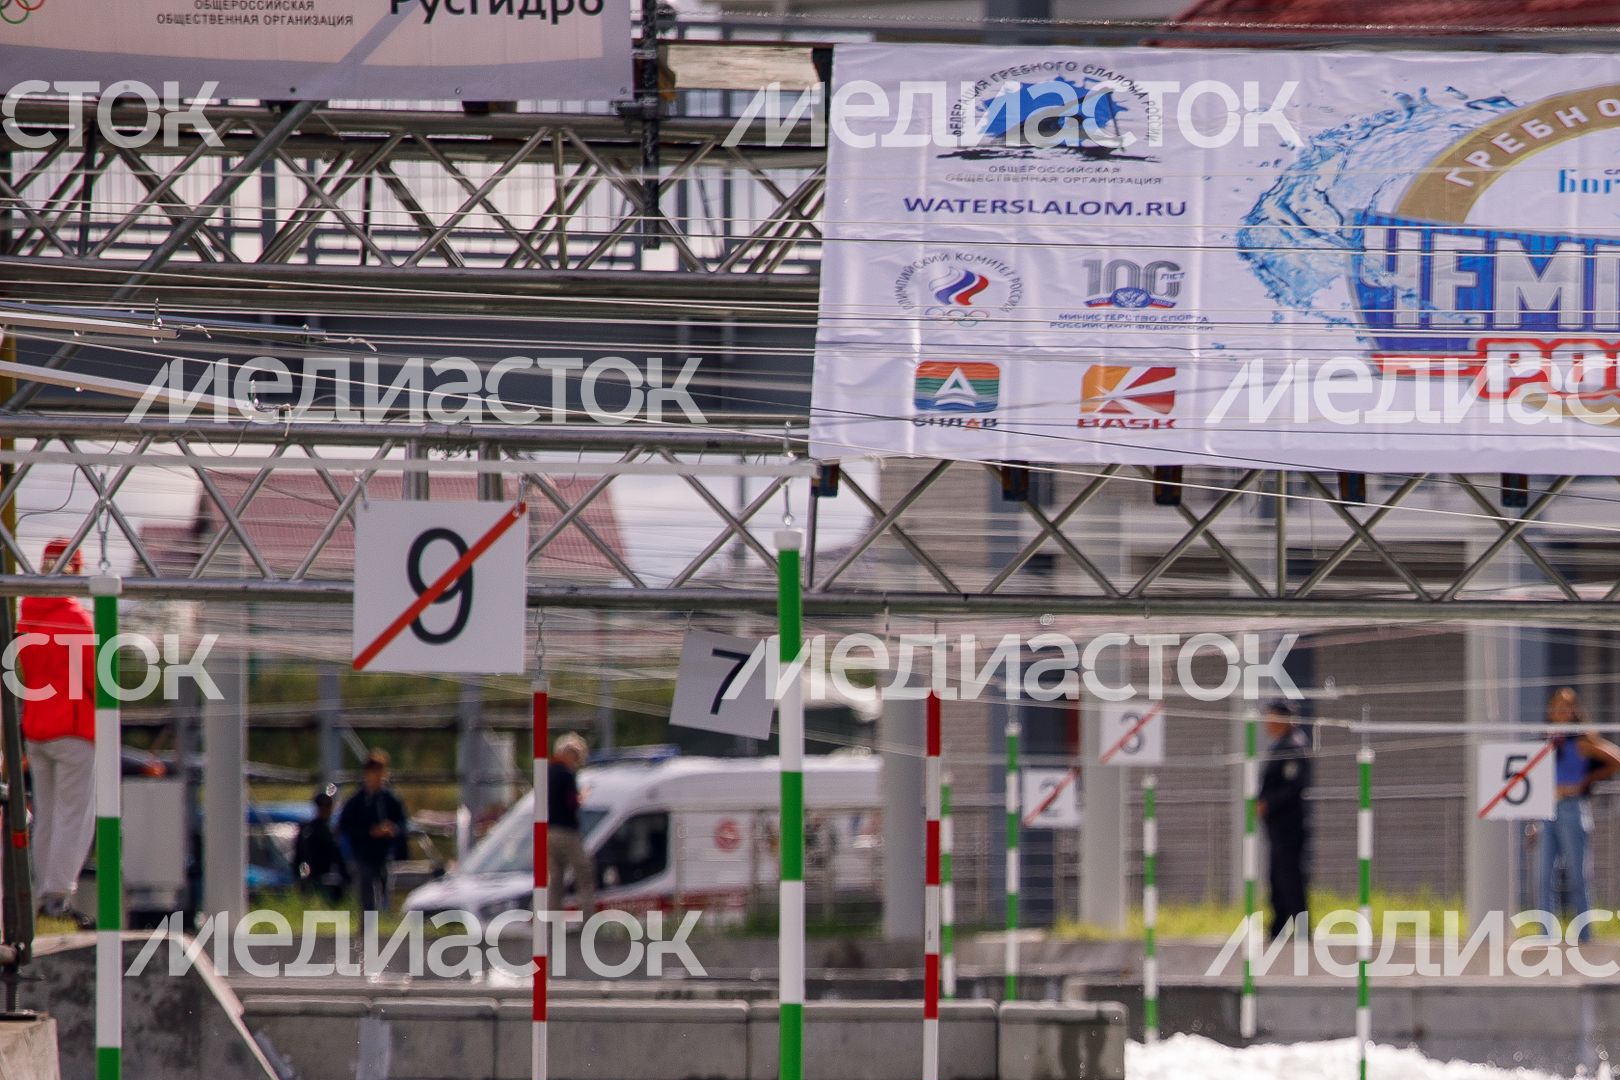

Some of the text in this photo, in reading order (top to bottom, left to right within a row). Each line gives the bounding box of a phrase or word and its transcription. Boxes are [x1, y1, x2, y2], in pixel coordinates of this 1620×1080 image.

[194, 0, 315, 11] ОБЩЕРОССИЙСКАЯ
[156, 14, 354, 27] ОБЩЕСТВЕННАЯ ОРГАНИЗАЦИЯ
[990, 60, 1079, 83] ГРЕБНОГО
[1082, 64, 1149, 101] СЛАЛОМА
[945, 173, 1162, 185] ОБЩЕСТВЕННАЯ ОРГАНИЗАЦИЯ
[988, 165, 1121, 174] ОБЩЕРОССИЙСКАЯ
[904, 197, 1188, 217] WATERSLALOM.RU
[954, 252, 1015, 277] КОМИТЕТ
[1058, 313, 1209, 324] МИНИСТЕРСТВО СПОРТА
[1077, 417, 1178, 429] BASK
[406, 526, 475, 645] 9
[710, 648, 750, 715] 7
[1119, 712, 1146, 755] 3
[1502, 754, 1532, 805] 5
